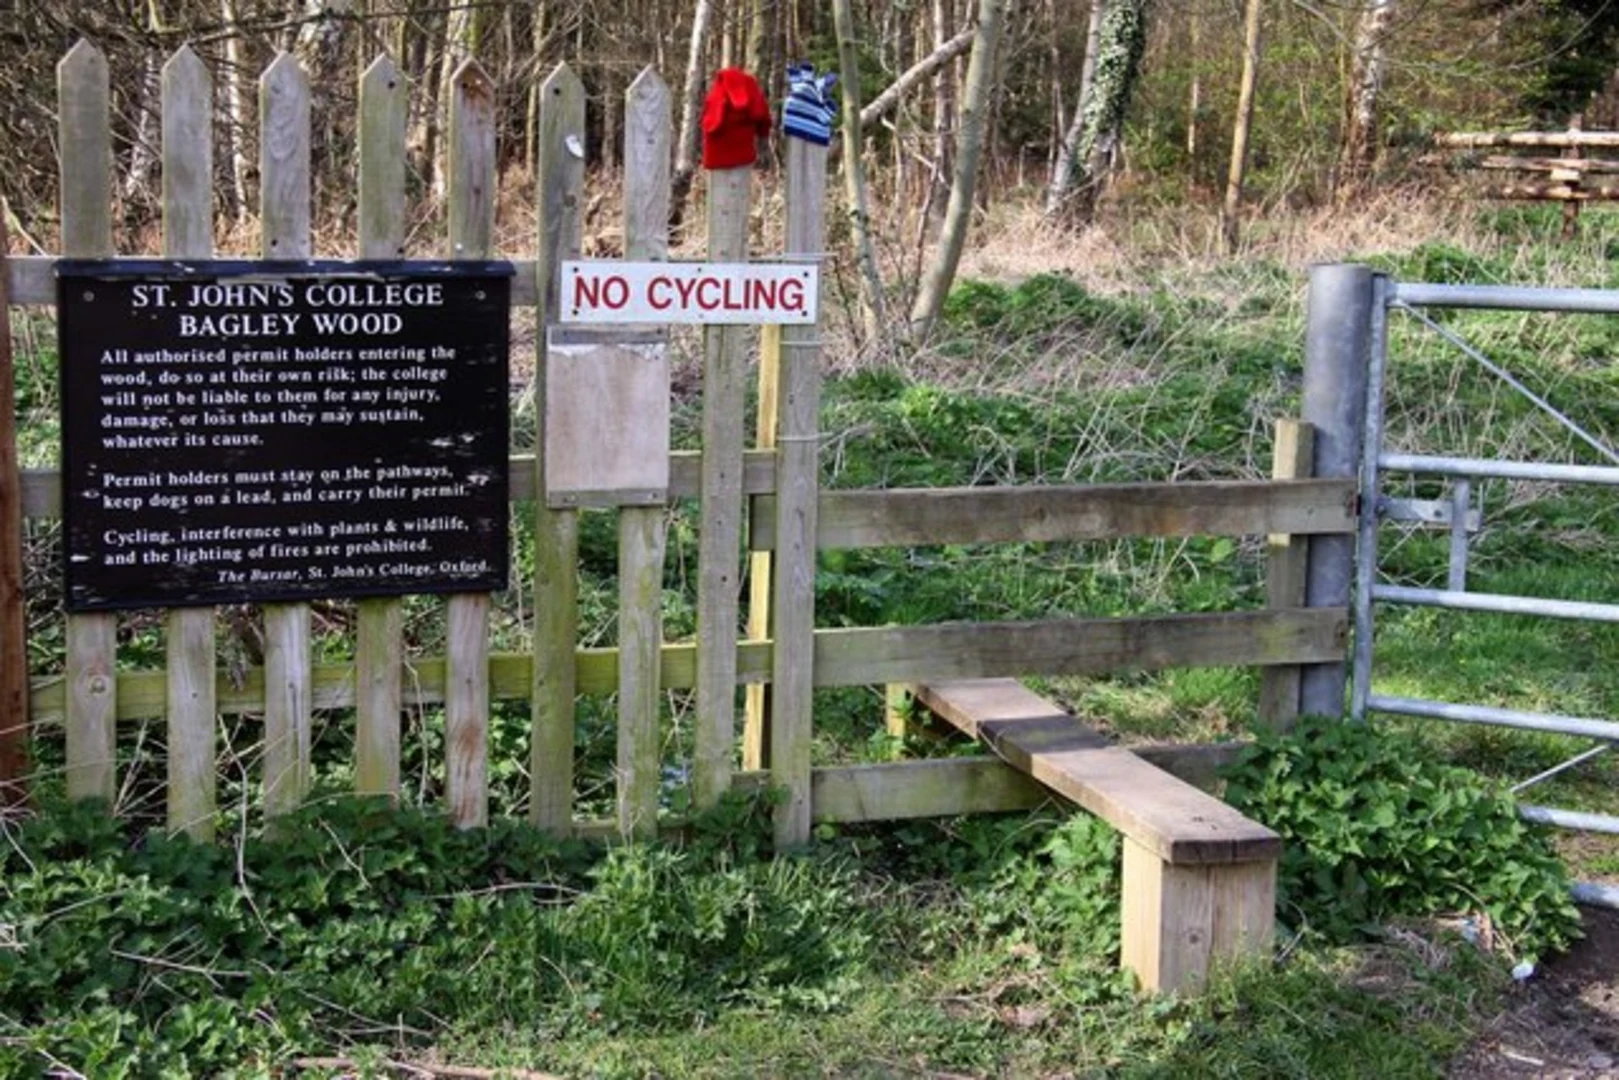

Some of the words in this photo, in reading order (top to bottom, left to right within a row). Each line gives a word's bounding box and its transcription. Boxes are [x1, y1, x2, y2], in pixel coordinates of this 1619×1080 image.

[132, 284, 176, 308] ST.
[188, 284, 294, 308] JOHN'S
[305, 283, 443, 307] COLLEGE
[575, 276, 629, 310] NO
[647, 277, 804, 311] CYCLING
[180, 313, 300, 336] BAGLEY
[312, 312, 402, 335] WOOD
[100, 349, 128, 364] All
[134, 349, 226, 363] authorised
[232, 347, 288, 365] permit
[295, 347, 352, 361] holders
[359, 346, 426, 363] entering
[432, 345, 456, 359] the
[159, 370, 181, 384] do
[185, 372, 203, 383] so
[209, 371, 226, 382] at
[232, 367, 272, 383] their
[278, 370, 312, 382] own
[362, 367, 387, 380] the
[392, 366, 448, 382] college
[101, 392, 135, 405] will
[143, 393, 170, 405] not
[176, 391, 196, 405] be
[202, 390, 248, 404] liable
[255, 391, 271, 403] to
[278, 388, 317, 402] them
[323, 387, 347, 401] for
[352, 390, 380, 404] any
[100, 413, 173, 430] damage,
[179, 415, 198, 425] or
[204, 411, 236, 425] loss
[242, 411, 274, 423] that
[281, 410, 315, 426] they
[321, 409, 354, 425] may
[102, 434, 179, 448] whatever
[184, 433, 206, 446] its
[212, 434, 264, 446] cause.
[103, 472, 161, 488] Permit
[168, 471, 228, 485] holders
[235, 471, 275, 484] must
[280, 470, 314, 483] stay
[321, 470, 340, 480] on
[345, 466, 370, 480] the
[103, 495, 142, 511] keep
[149, 493, 188, 509] dogs
[194, 494, 215, 504] on
[220, 492, 230, 504] a
[283, 488, 312, 502] and
[318, 489, 362, 503] carry
[368, 485, 407, 499] their
[181, 526, 281, 540] interference
[288, 523, 324, 537] with
[330, 521, 379, 538] plants
[384, 518, 397, 532] &
[404, 515, 469, 532] wildlife,
[104, 551, 137, 565] and
[143, 550, 170, 564] the
[176, 547, 242, 565] lighting
[248, 544, 264, 558] of
[270, 544, 309, 557] fires
[314, 544, 340, 555] are
[346, 538, 432, 557] prohibited.
[217, 570, 246, 583] The
[308, 566, 326, 578] St.
[331, 565, 374, 577] John's
